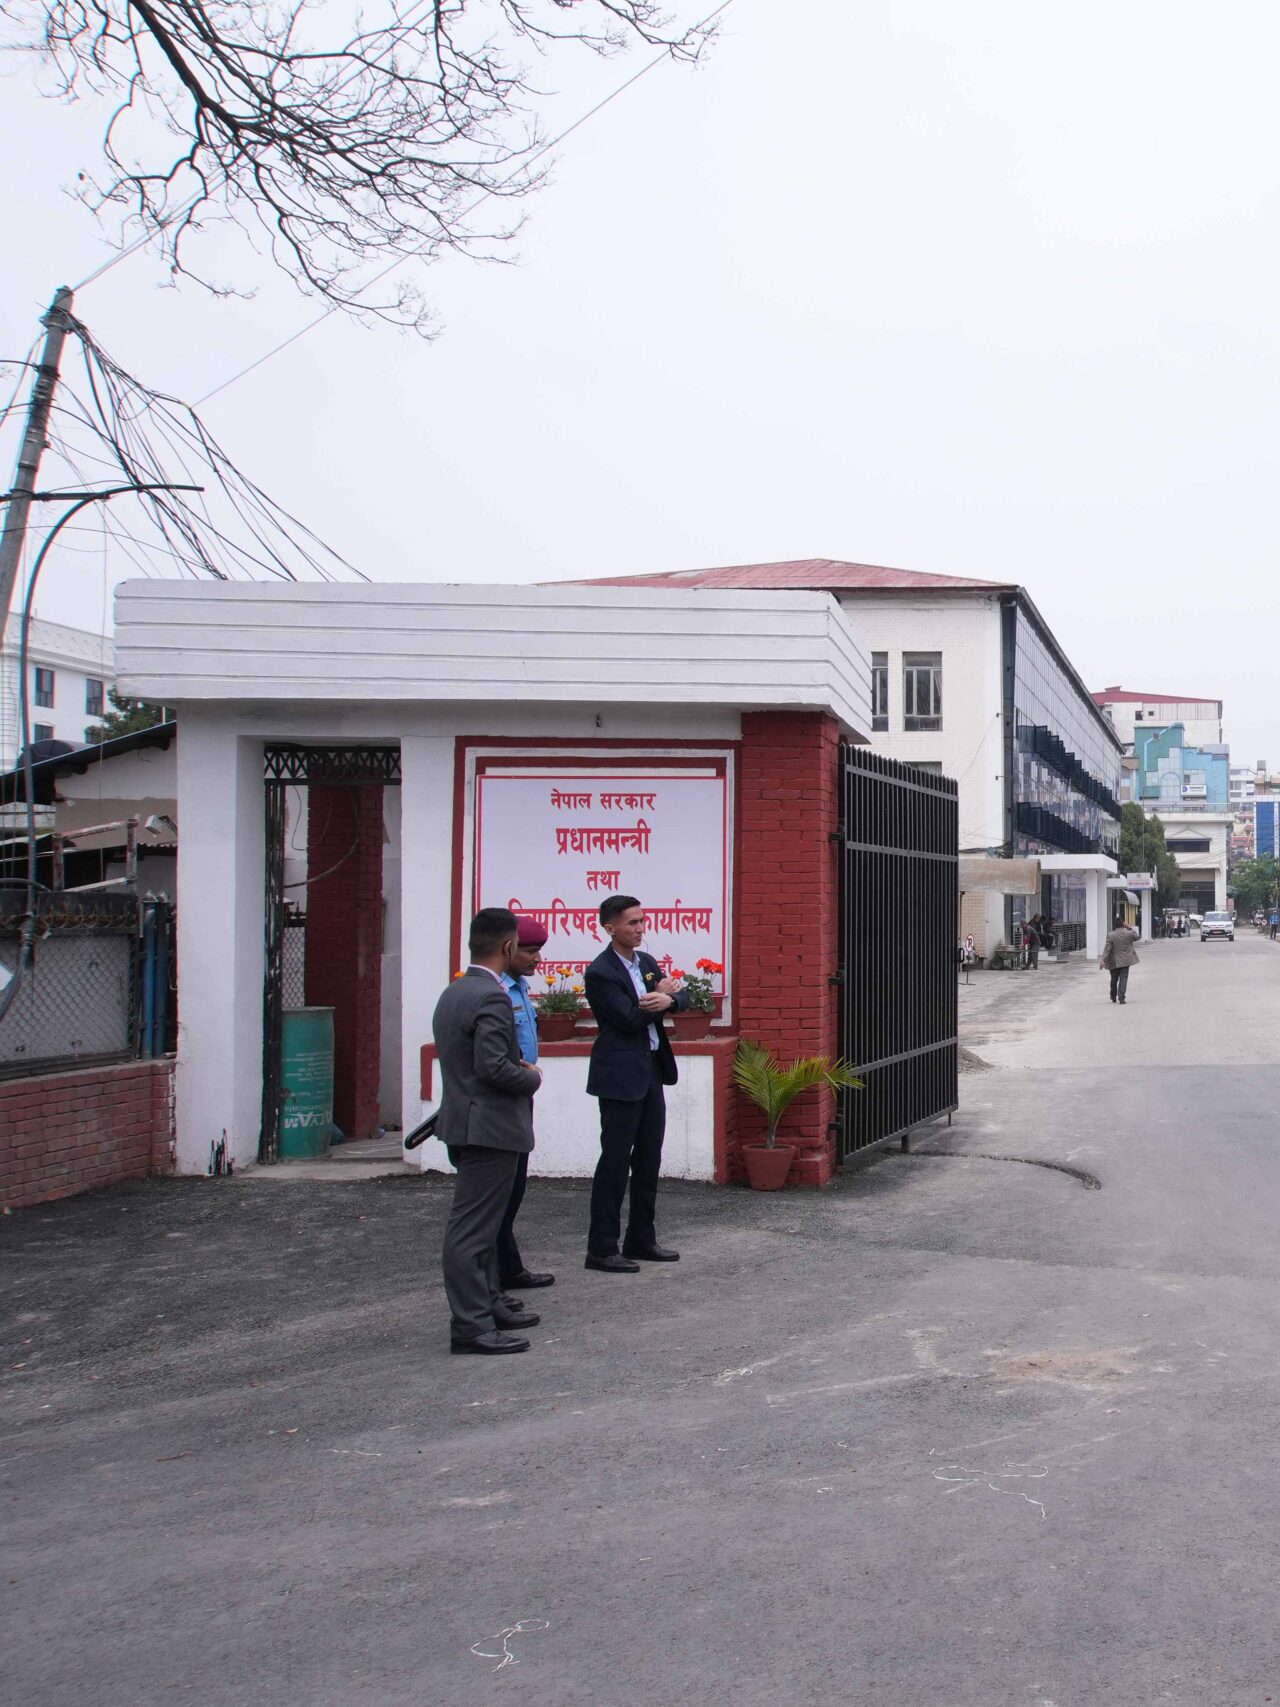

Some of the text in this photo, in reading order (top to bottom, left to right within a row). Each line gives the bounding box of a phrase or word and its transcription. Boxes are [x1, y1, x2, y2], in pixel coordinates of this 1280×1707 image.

[551, 788, 656, 810] नेपाल सरकार
[556, 819, 651, 854] प्रधानमन्त्री
[587, 871, 620, 890] तथा
